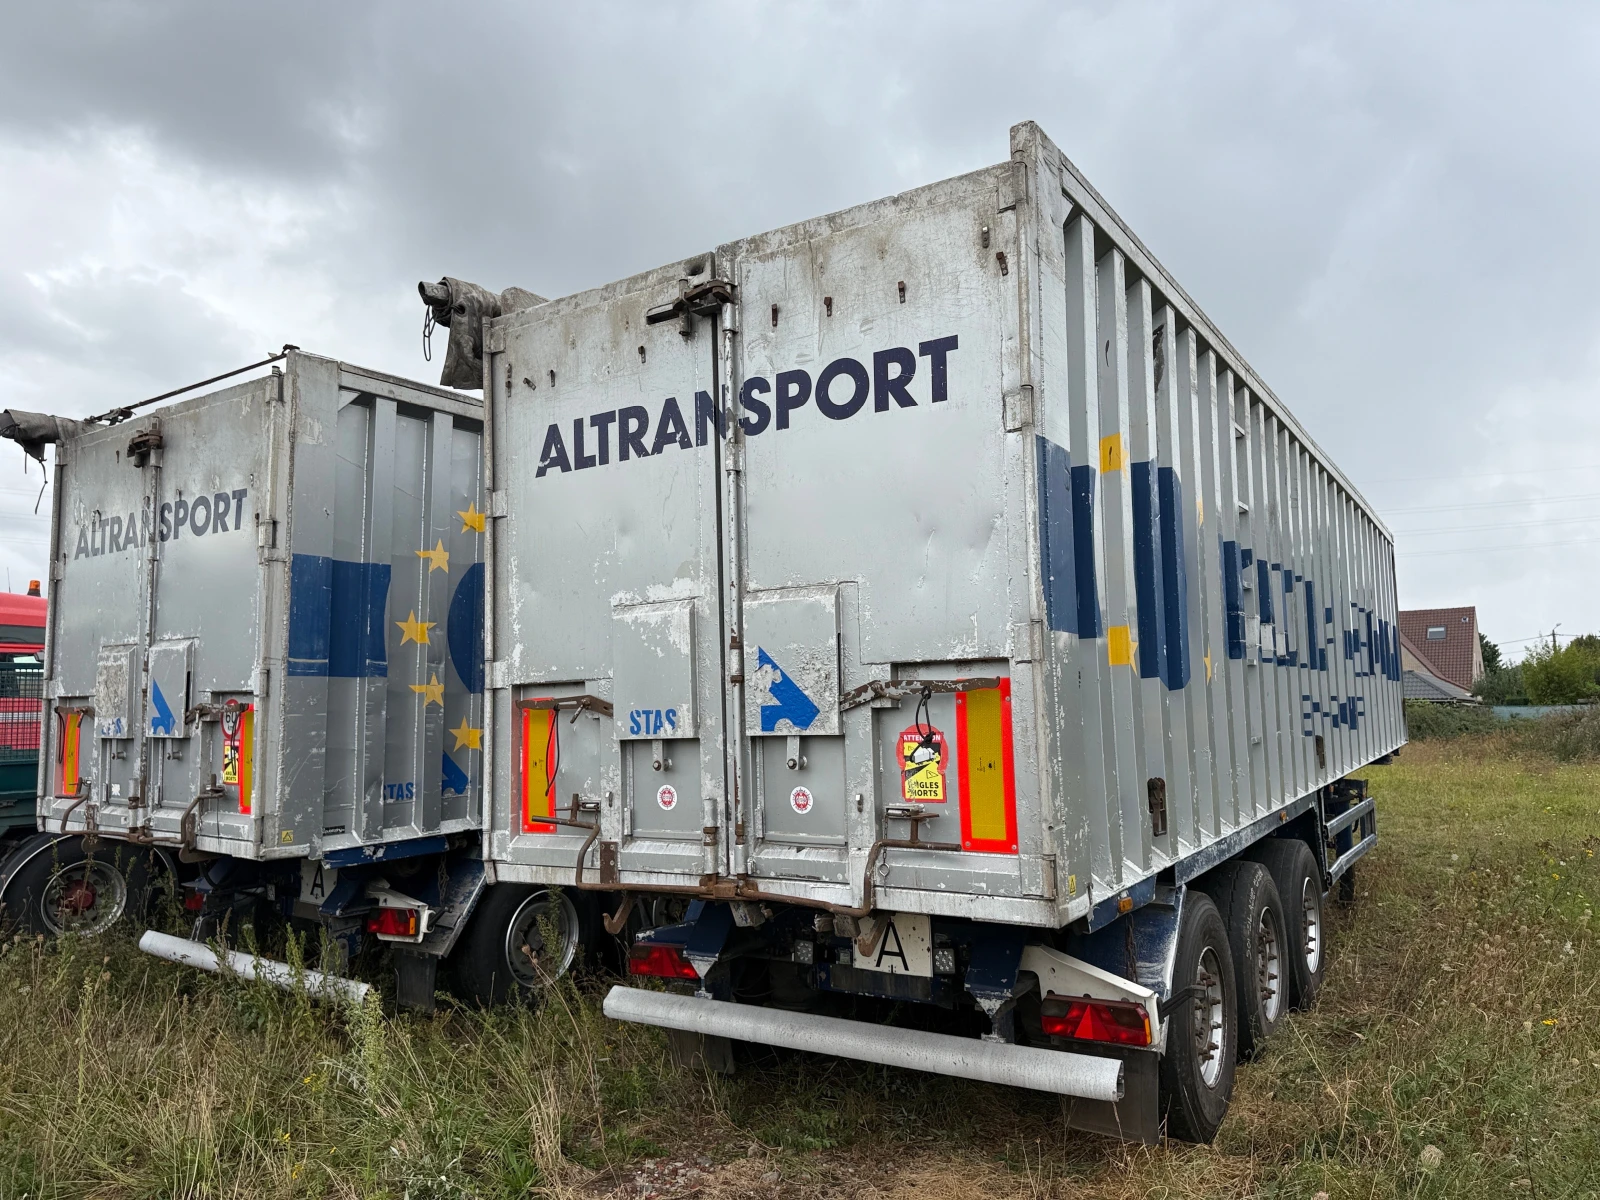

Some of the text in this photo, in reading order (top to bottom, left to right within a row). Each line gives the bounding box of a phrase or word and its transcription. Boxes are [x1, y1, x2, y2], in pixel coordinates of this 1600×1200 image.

[535, 334, 959, 478] ALTRANSPORT
[74, 488, 248, 560] ALTRANSPORT
[629, 708, 677, 735] STAS
[908, 780, 939, 789] GLES
[310, 861, 325, 897] A
[875, 918, 909, 971] A
